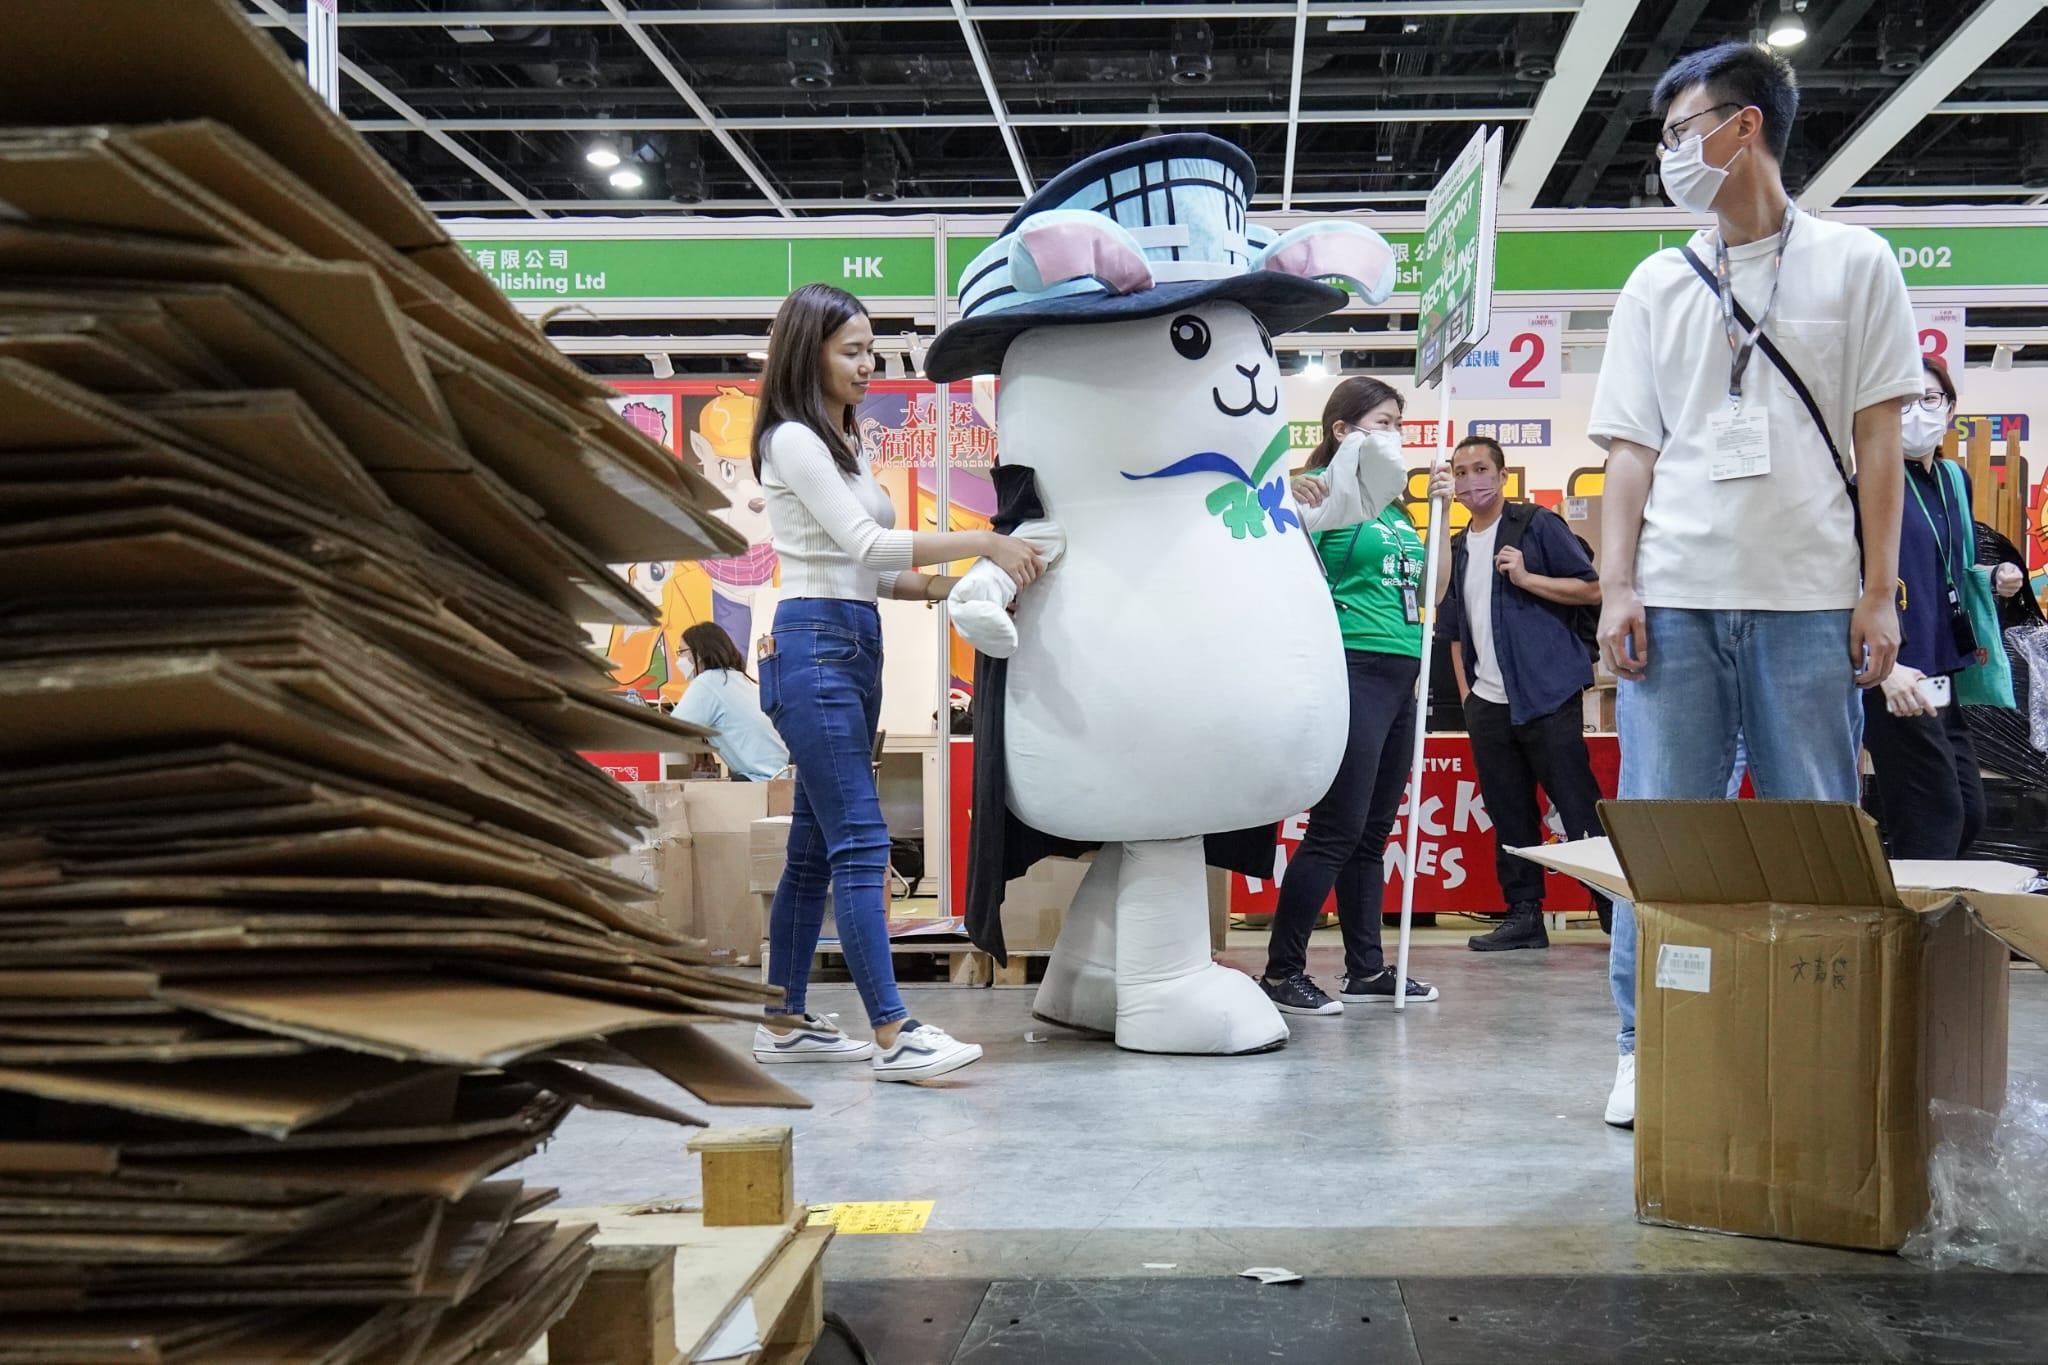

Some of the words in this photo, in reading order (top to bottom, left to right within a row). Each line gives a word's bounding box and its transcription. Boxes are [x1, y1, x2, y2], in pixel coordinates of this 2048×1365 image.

[1426, 180, 1476, 260] SUPPORT
[464, 248, 569, 270] 有限公司
[843, 256, 884, 278] HK
[575, 271, 605, 290] Ltd
[1420, 236, 1477, 322] RECYCLING
[1508, 332, 1546, 388] 2
